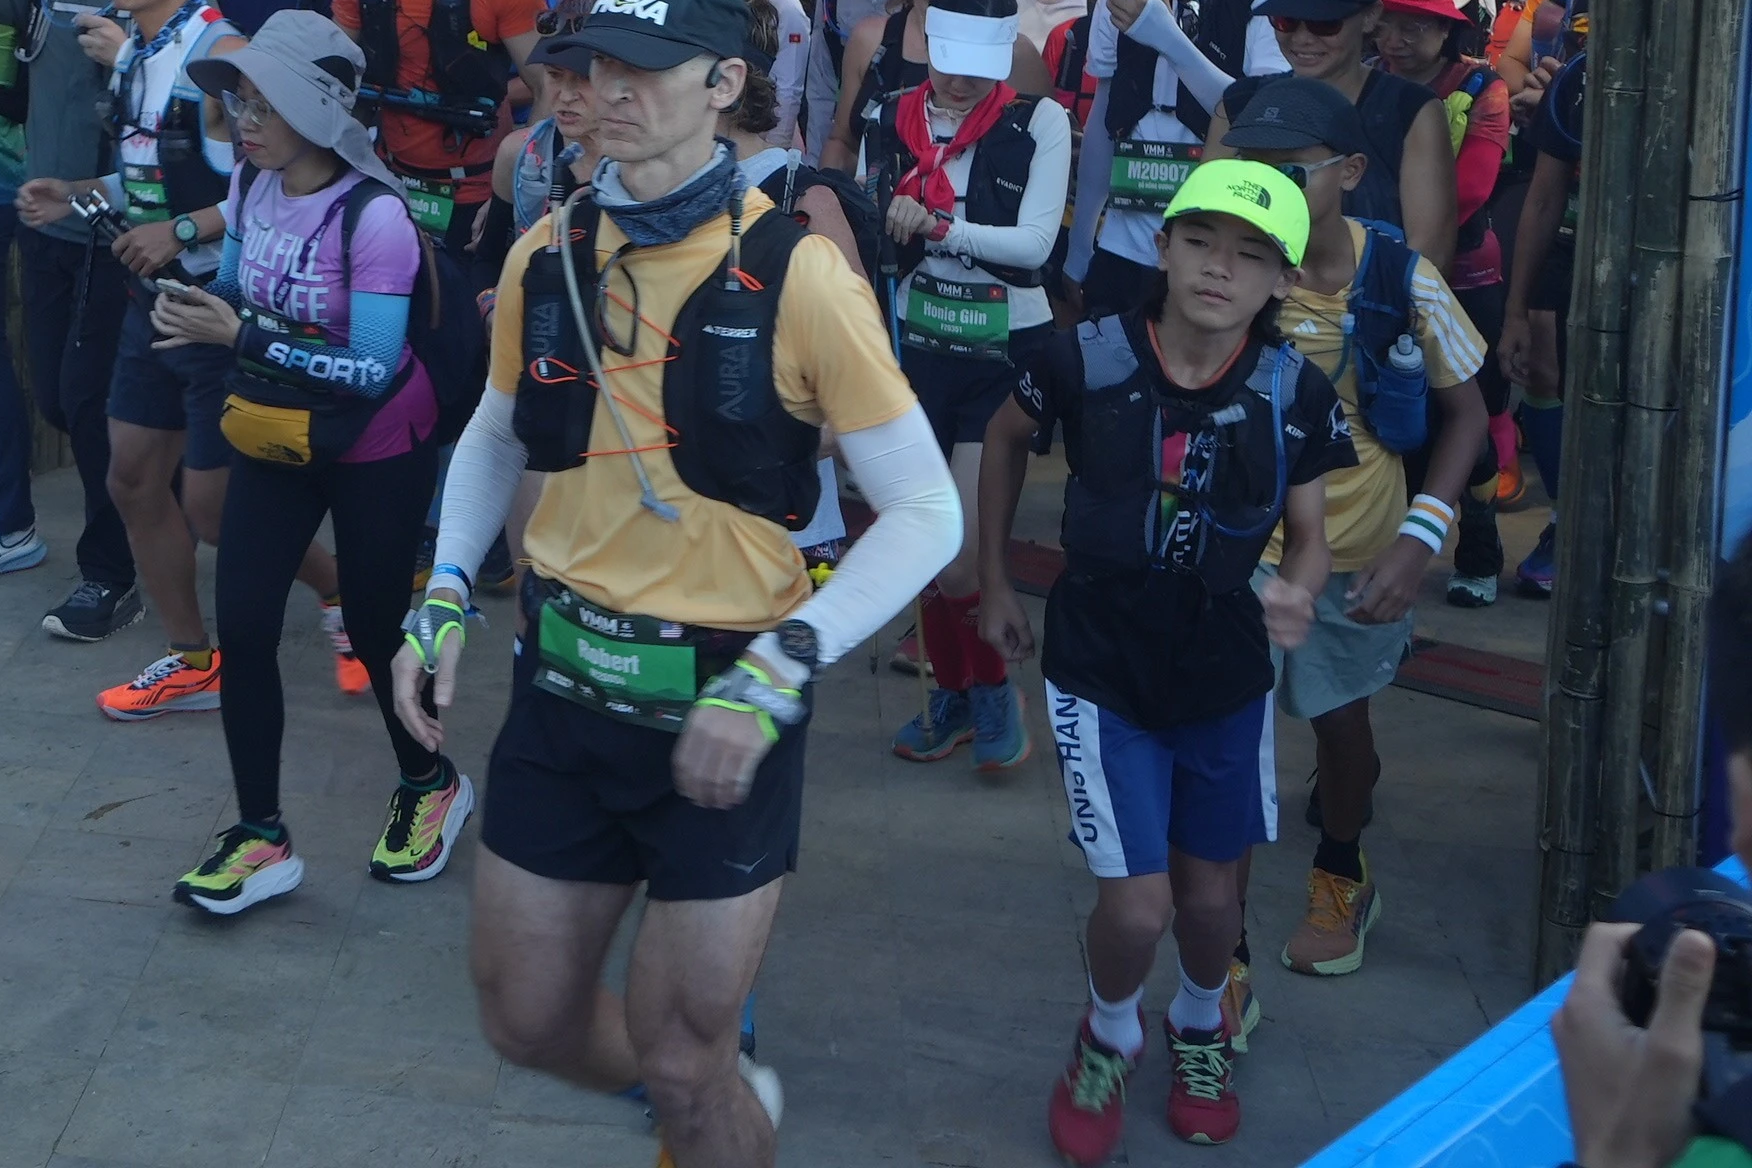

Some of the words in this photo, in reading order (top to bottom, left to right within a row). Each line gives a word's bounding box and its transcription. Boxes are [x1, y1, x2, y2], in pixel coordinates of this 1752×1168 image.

[1142, 143, 1166, 156] VMM
[1127, 160, 1190, 183] M20907
[1226, 183, 1260, 197] NORTH
[1243, 179, 1261, 190] THE
[1232, 190, 1258, 203] FACE
[935, 281, 963, 299] VMM
[923, 300, 956, 323] Honie
[264, 341, 387, 387] SPORTS
[576, 637, 641, 676] Robert
